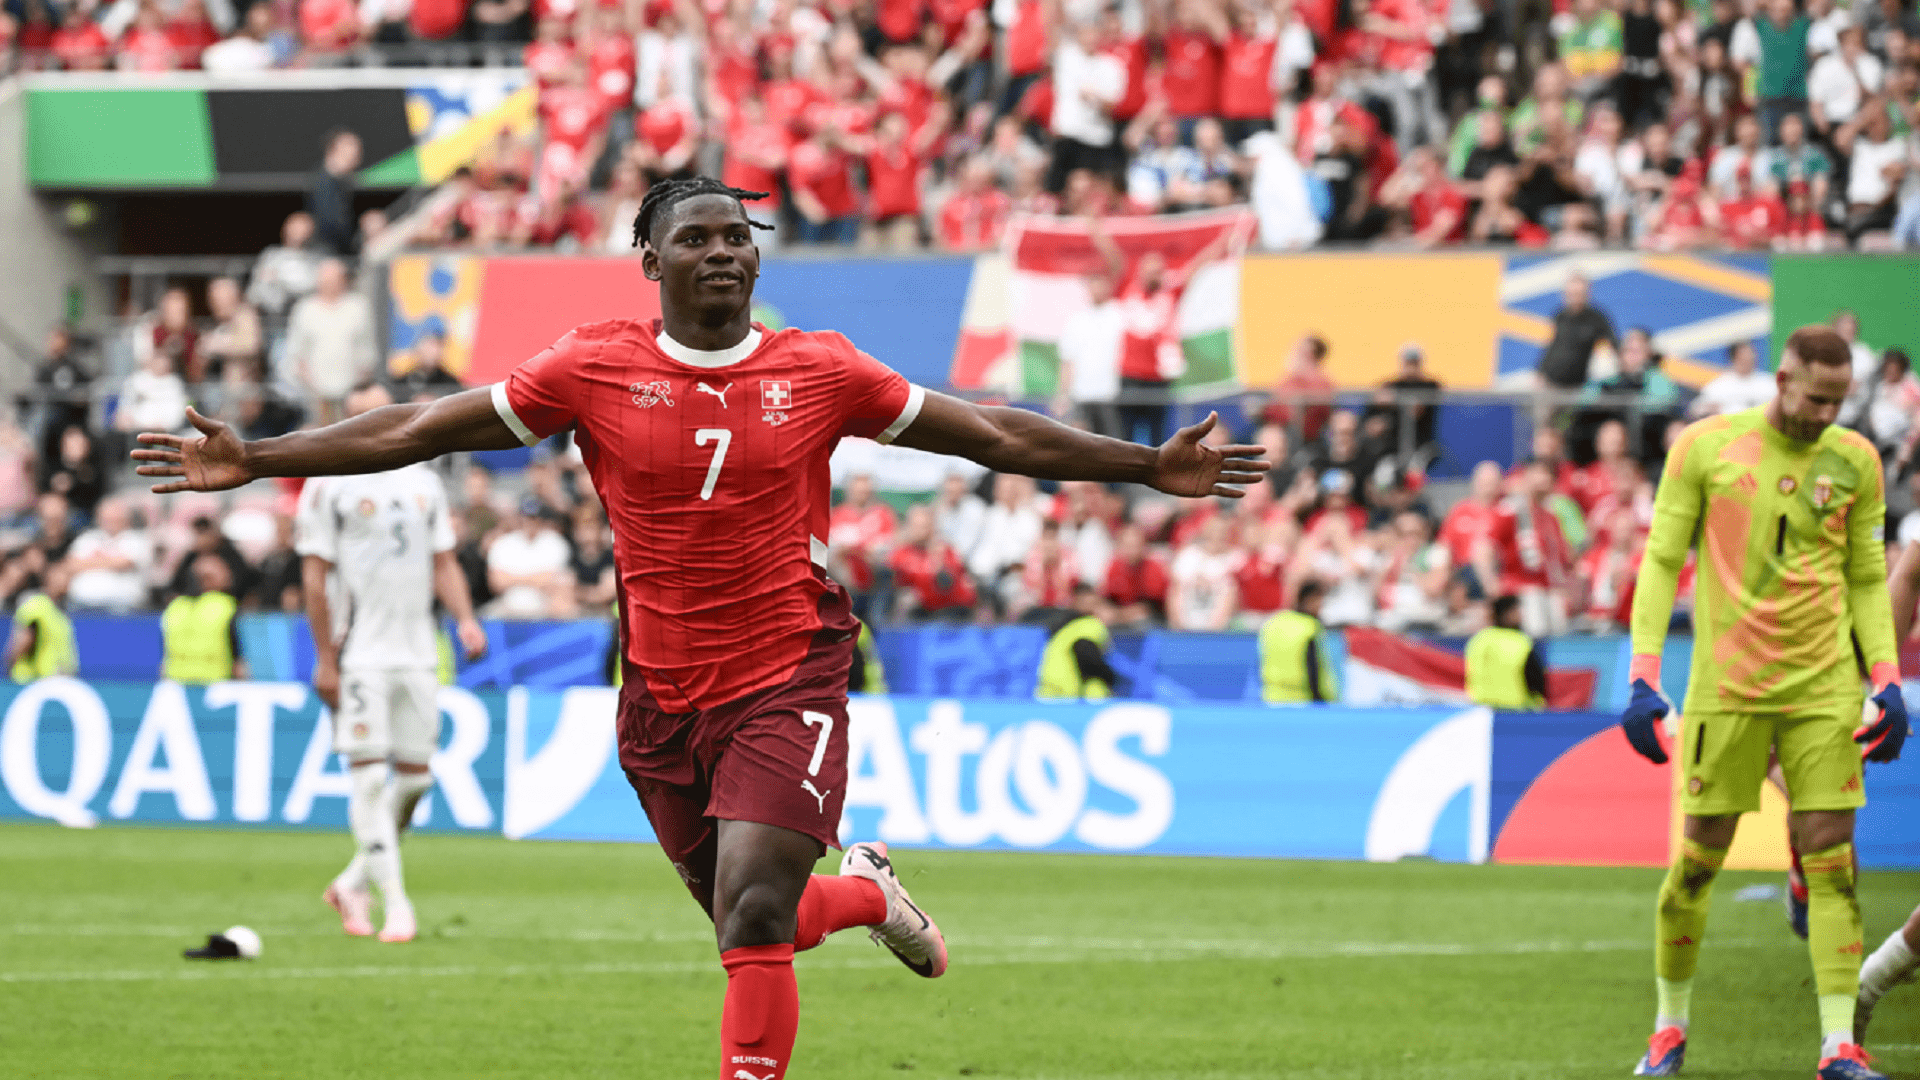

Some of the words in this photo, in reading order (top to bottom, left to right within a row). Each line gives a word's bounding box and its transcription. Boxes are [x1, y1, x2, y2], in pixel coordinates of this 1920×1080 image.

[695, 429, 732, 500] 7
[390, 519, 410, 558] 5
[1776, 514, 1786, 555] 1
[0, 676, 494, 828] QATAR
[802, 710, 834, 777] 7
[1695, 721, 1705, 764] 1
[731, 1055, 778, 1068] SUISSE
